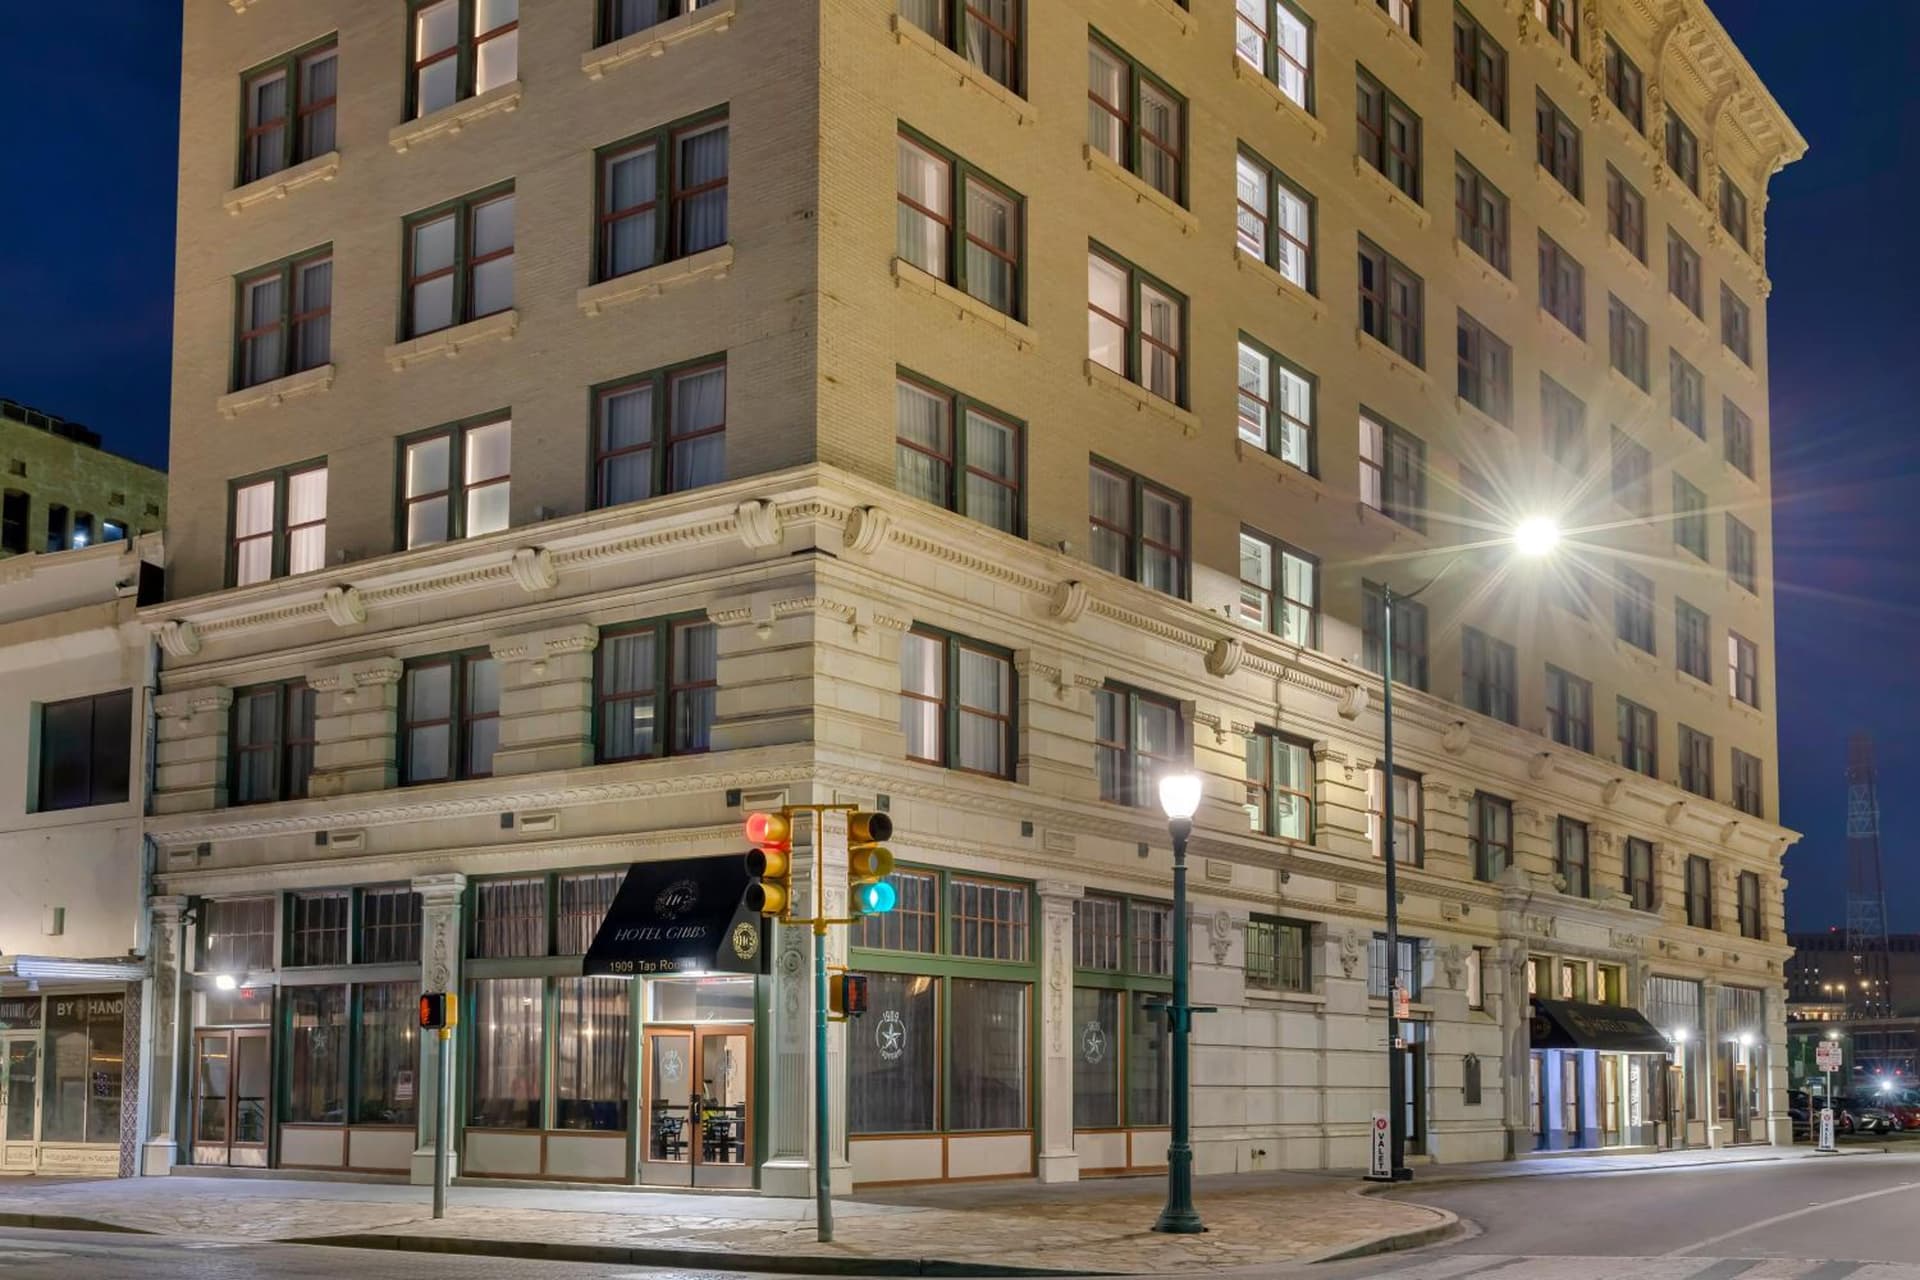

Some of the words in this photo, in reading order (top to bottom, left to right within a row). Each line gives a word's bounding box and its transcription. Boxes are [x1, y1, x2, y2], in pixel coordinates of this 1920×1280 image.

[614, 927, 662, 941] HOTEL
[666, 925, 706, 940] GIBBS
[609, 961, 633, 973] 1909
[638, 960, 656, 972] Tap
[56, 1002, 74, 1016] BY
[88, 1000, 124, 1014] HAND
